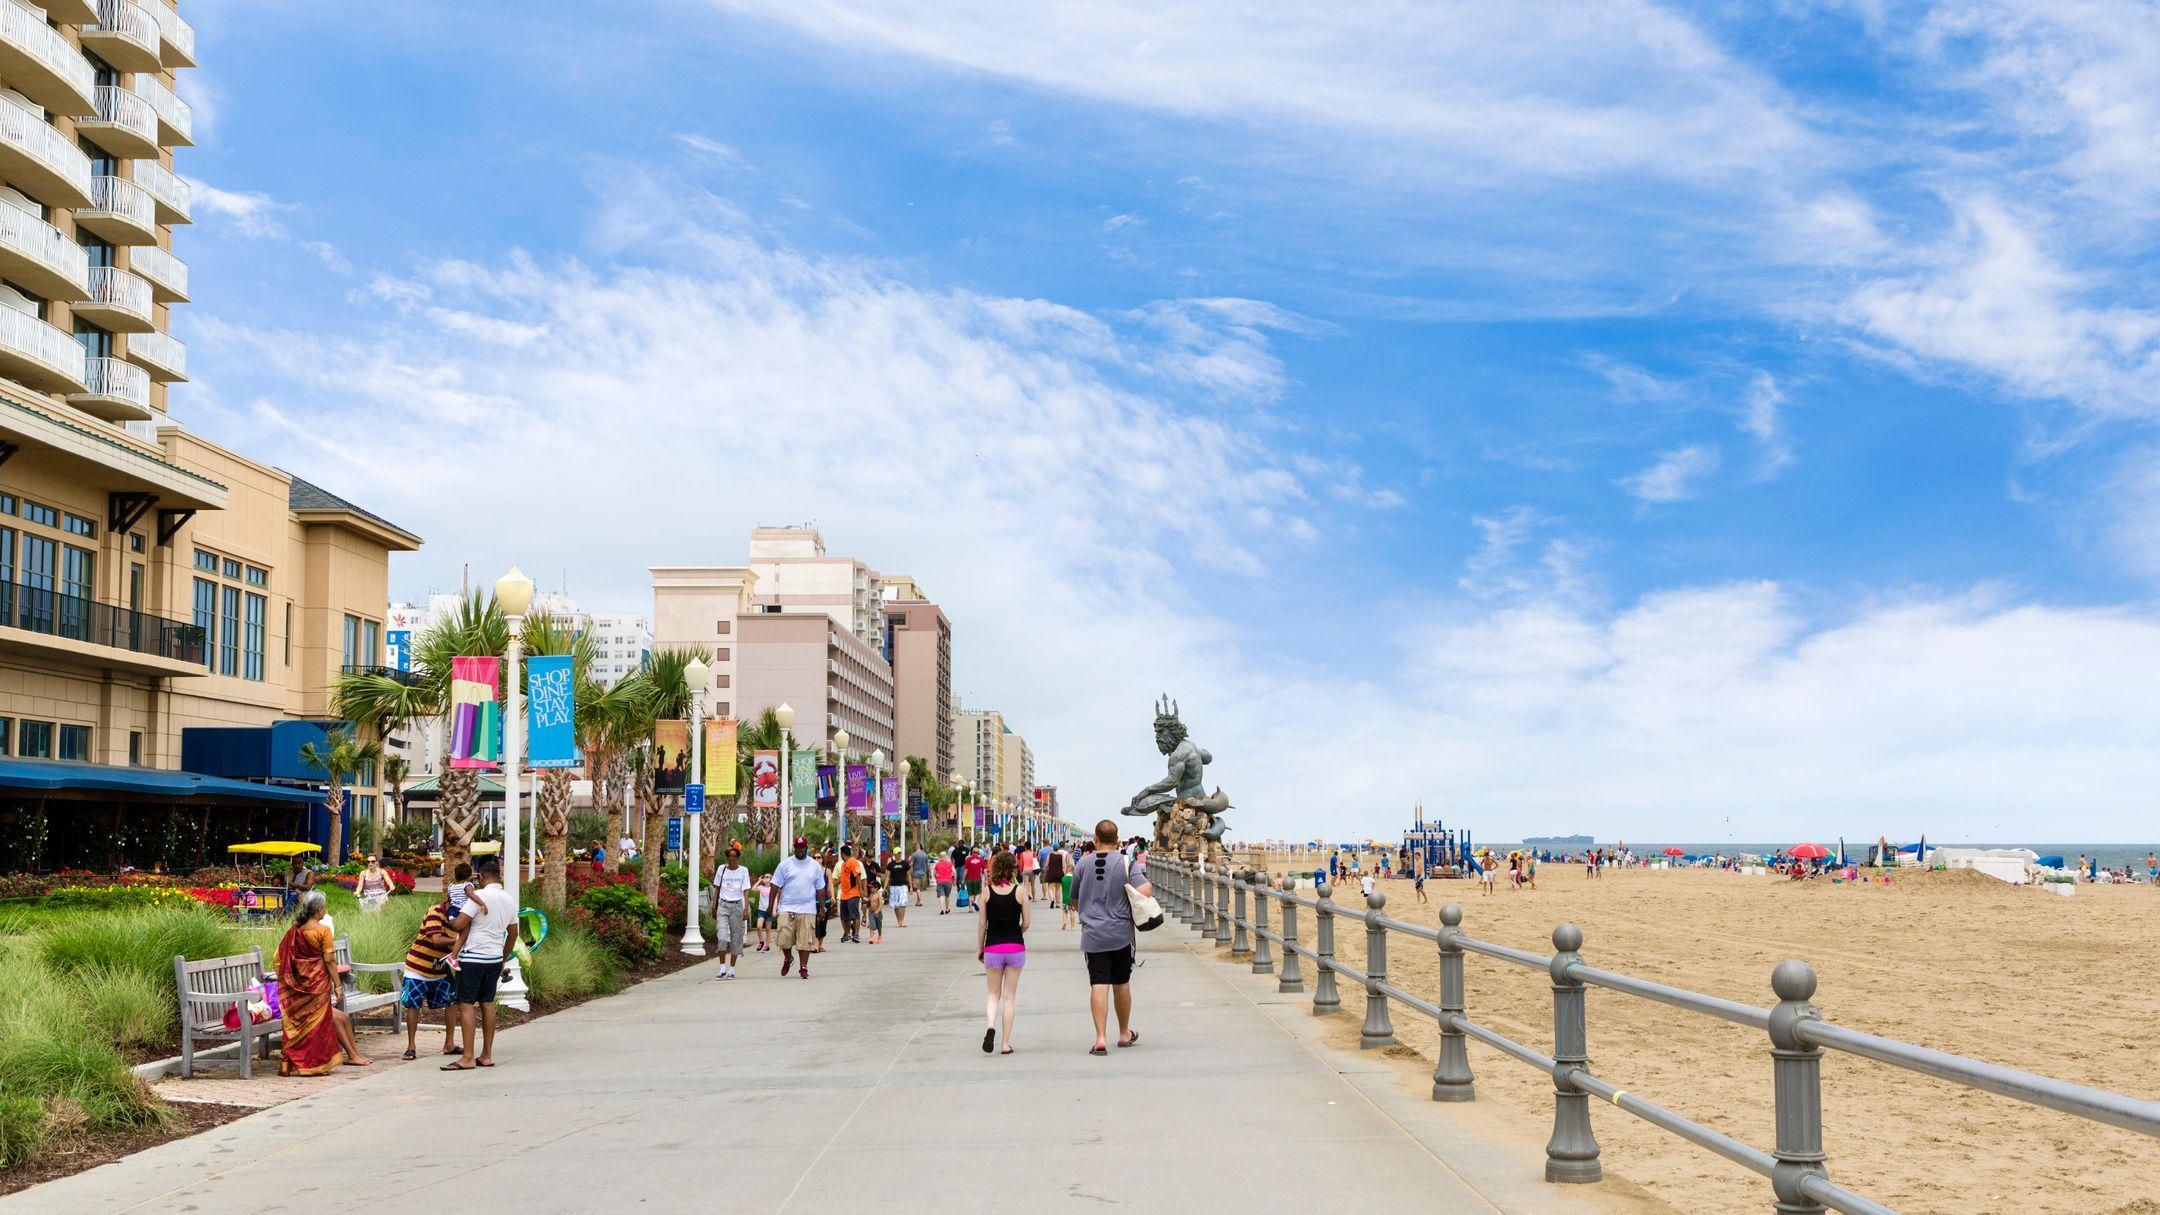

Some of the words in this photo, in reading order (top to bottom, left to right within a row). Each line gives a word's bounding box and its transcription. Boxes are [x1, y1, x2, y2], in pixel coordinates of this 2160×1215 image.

[529, 668, 571, 689] SHOP.
[531, 682, 572, 702] DINE.
[533, 695, 569, 715] STAY.
[535, 708, 571, 728] PLAY.
[692, 795, 697, 805] 2
